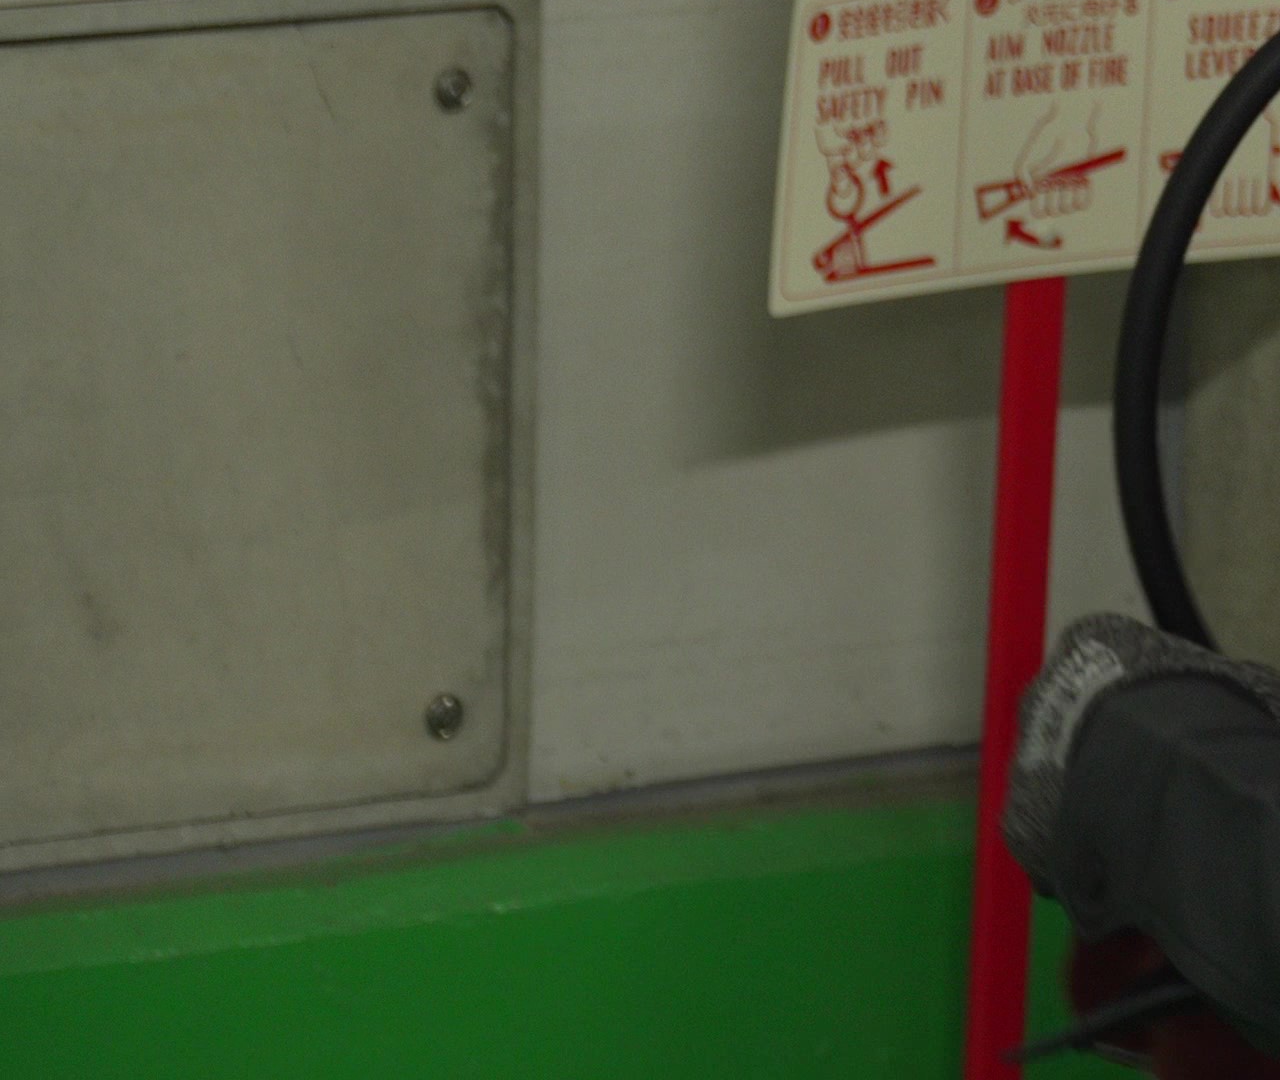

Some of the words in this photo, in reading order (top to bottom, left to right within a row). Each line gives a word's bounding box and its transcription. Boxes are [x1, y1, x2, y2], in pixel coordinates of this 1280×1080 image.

[987, 32, 1025, 62] AIM
[1042, 21, 1115, 57] NOZZLE
[818, 55, 865, 88] PULL
[885, 43, 923, 78] OUT
[984, 69, 1005, 98] AT
[1011, 64, 1054, 97] BASE
[1060, 60, 1081, 91] OF
[1087, 55, 1128, 88] FIRE
[817, 86, 887, 124] SAFETY
[905, 78, 945, 110] PIN
